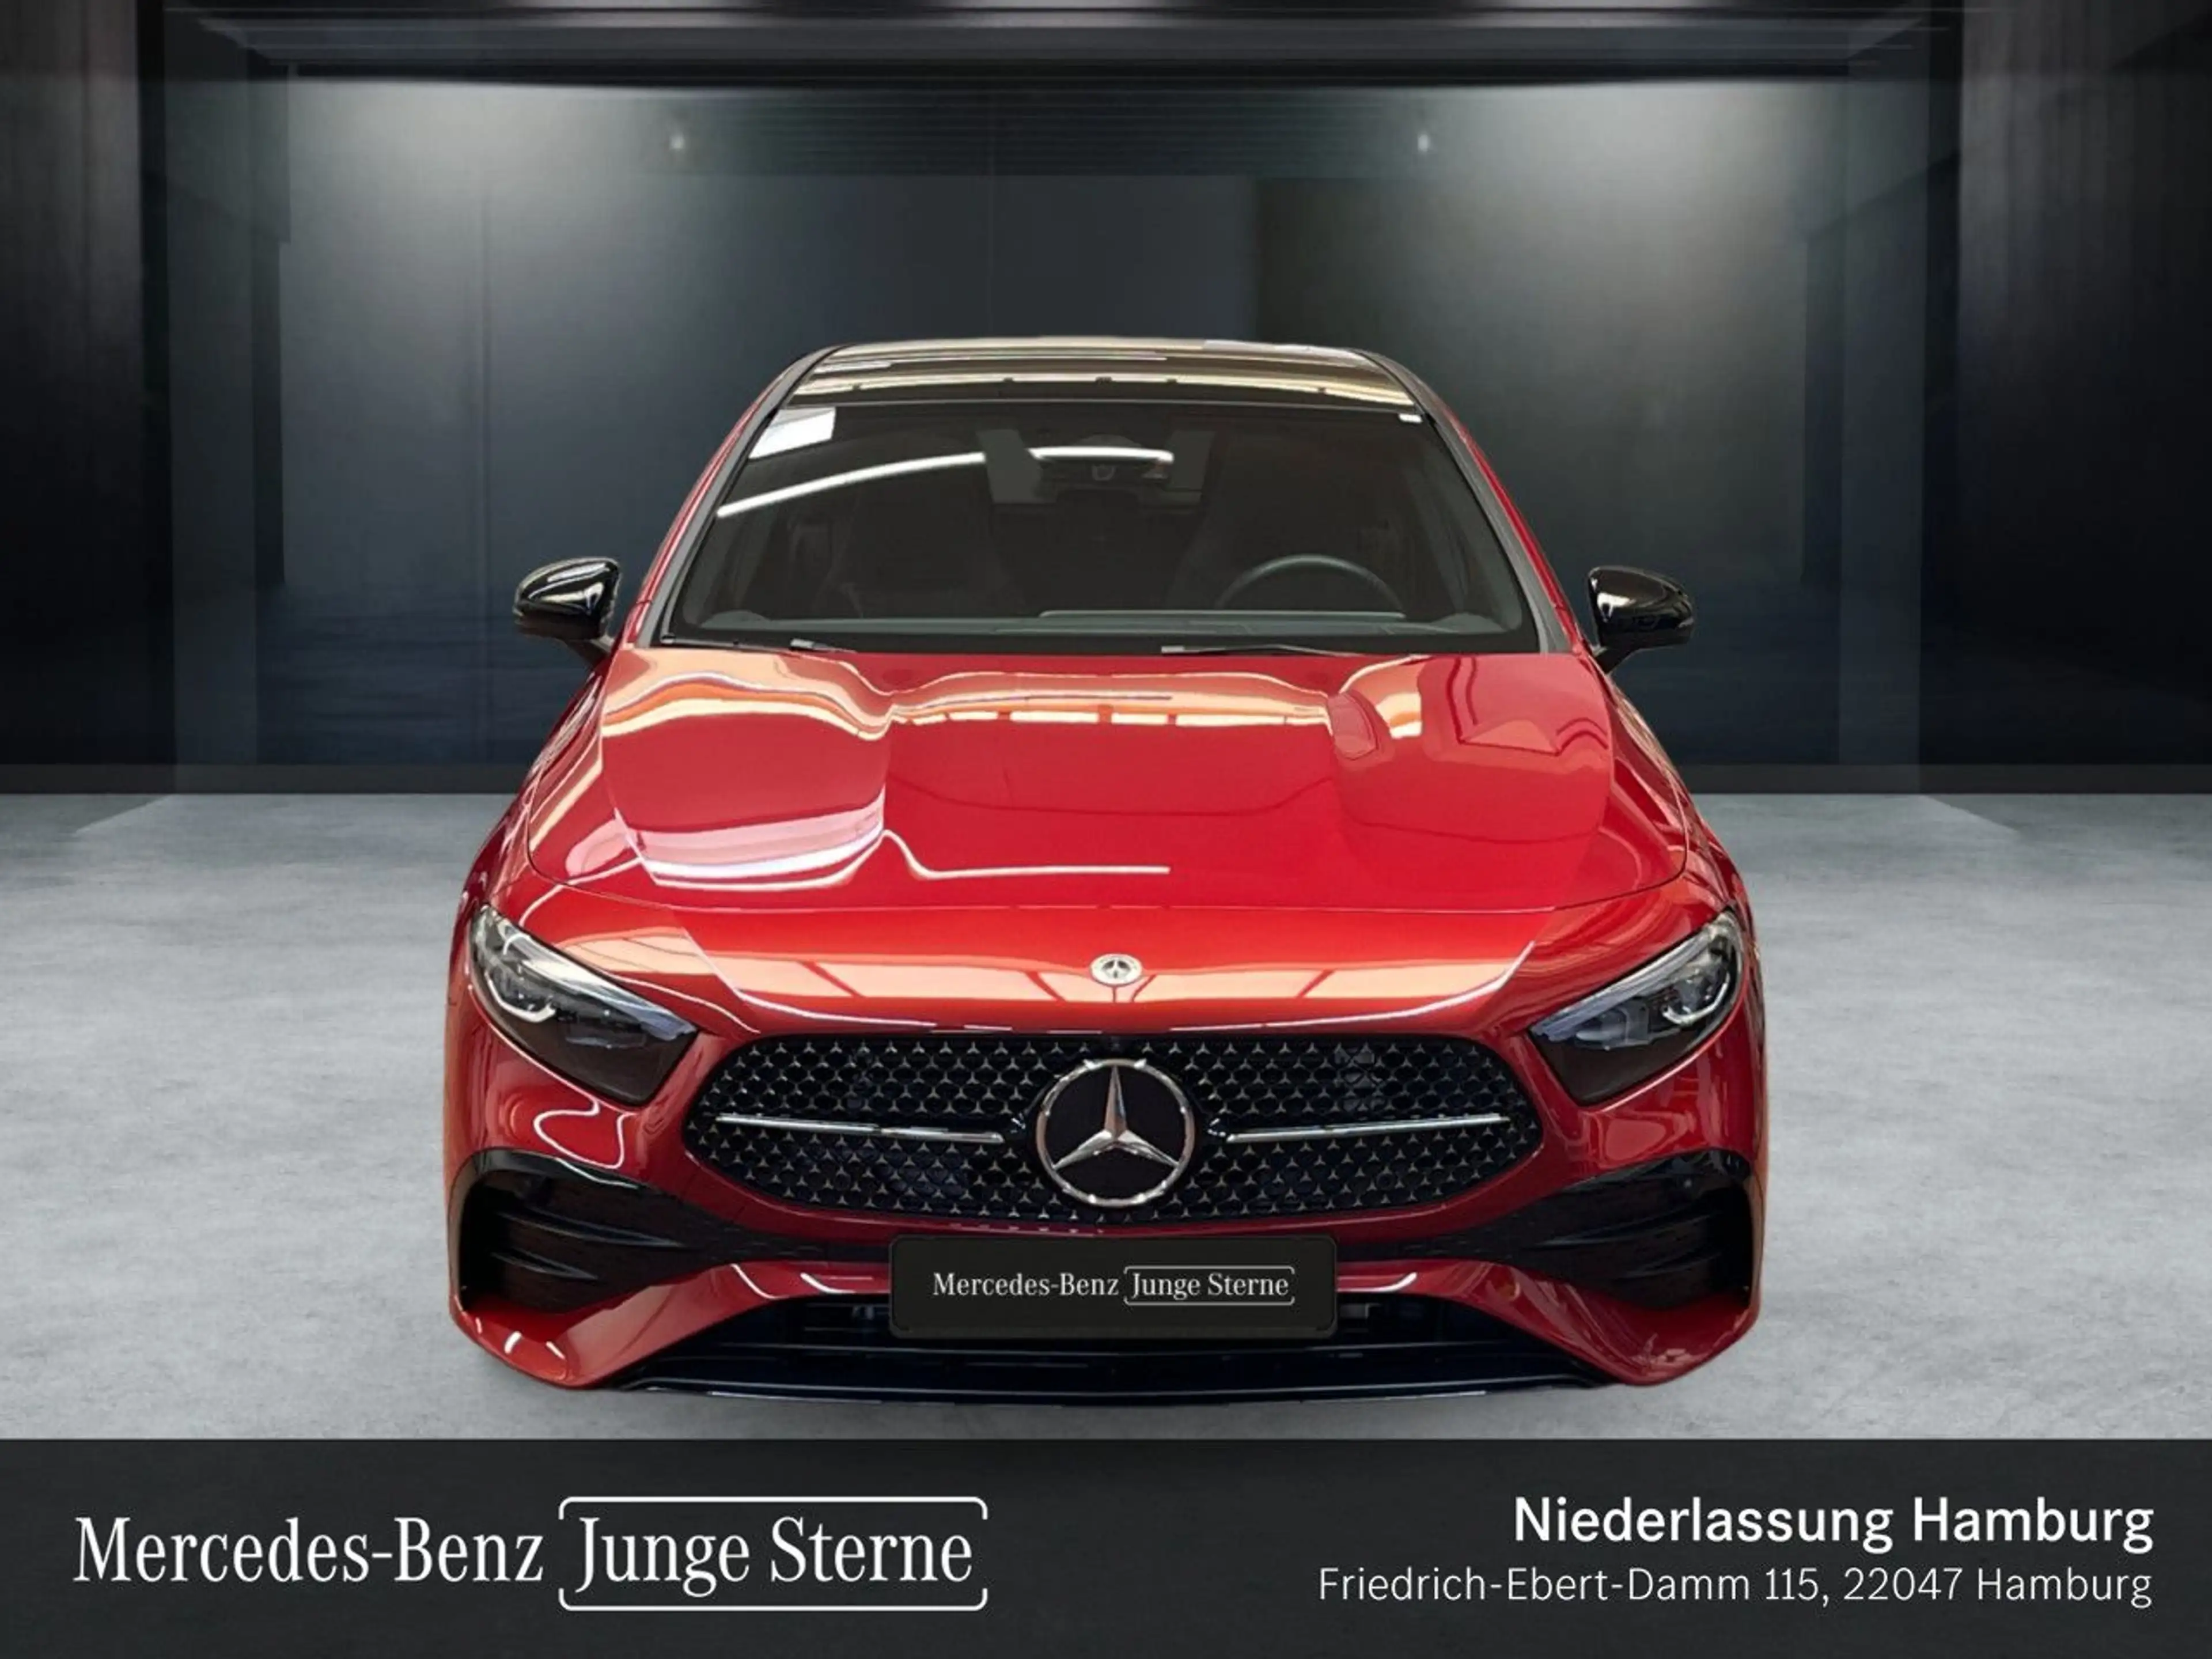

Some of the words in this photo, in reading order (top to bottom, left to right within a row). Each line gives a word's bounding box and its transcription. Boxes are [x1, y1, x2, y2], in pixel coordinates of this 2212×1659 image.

[933, 1272, 1119, 1296] Mercedes-Benz
[1131, 1272, 1200, 1301] Junge
[1207, 1272, 1289, 1296] Sterne
